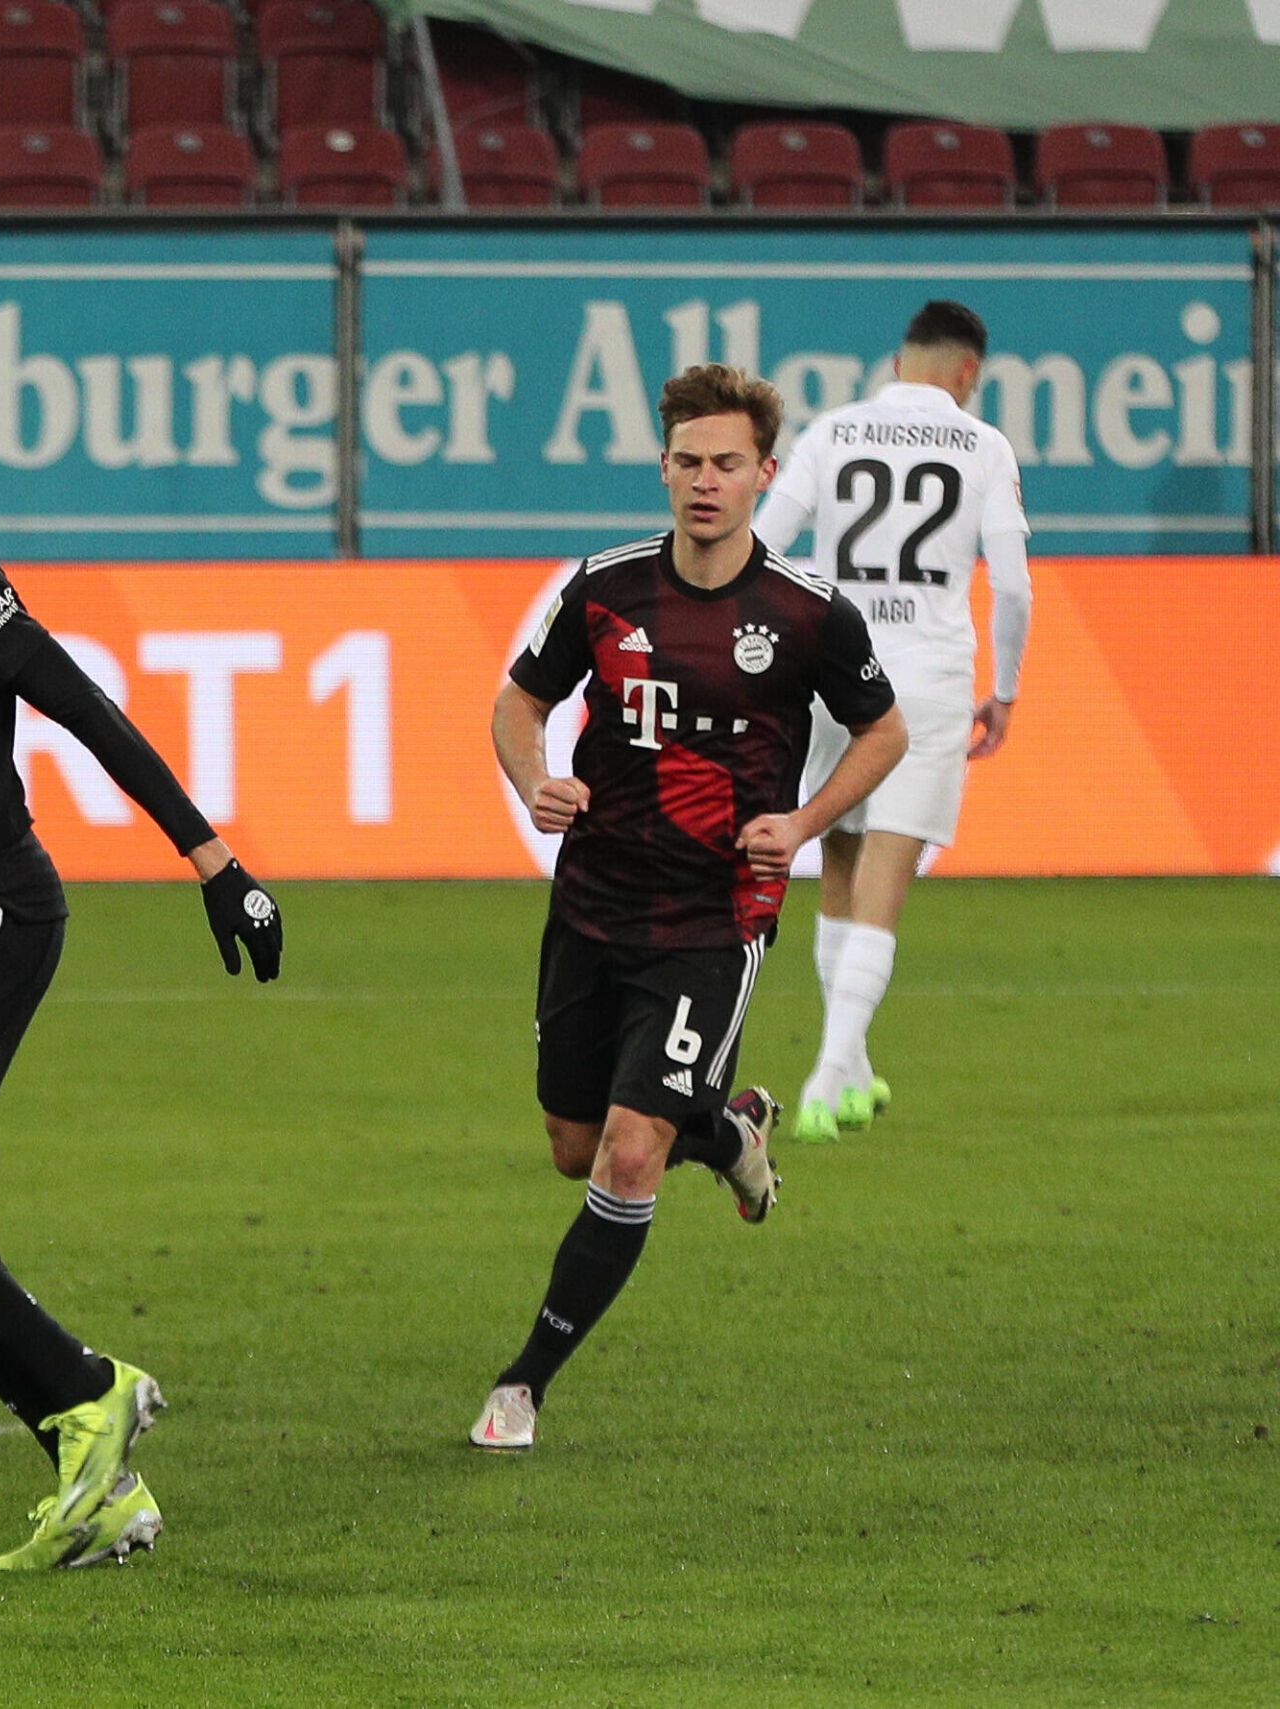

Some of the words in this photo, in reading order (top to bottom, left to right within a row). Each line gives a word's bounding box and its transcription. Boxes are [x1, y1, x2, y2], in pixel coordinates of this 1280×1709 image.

[543, 298, 1254, 472] Agmei
[832, 424, 857, 446] FC
[862, 423, 978, 452] AUGSBURG
[836, 458, 963, 589] 22
[871, 598, 916, 625] IAGO
[664, 994, 703, 1066] 6
